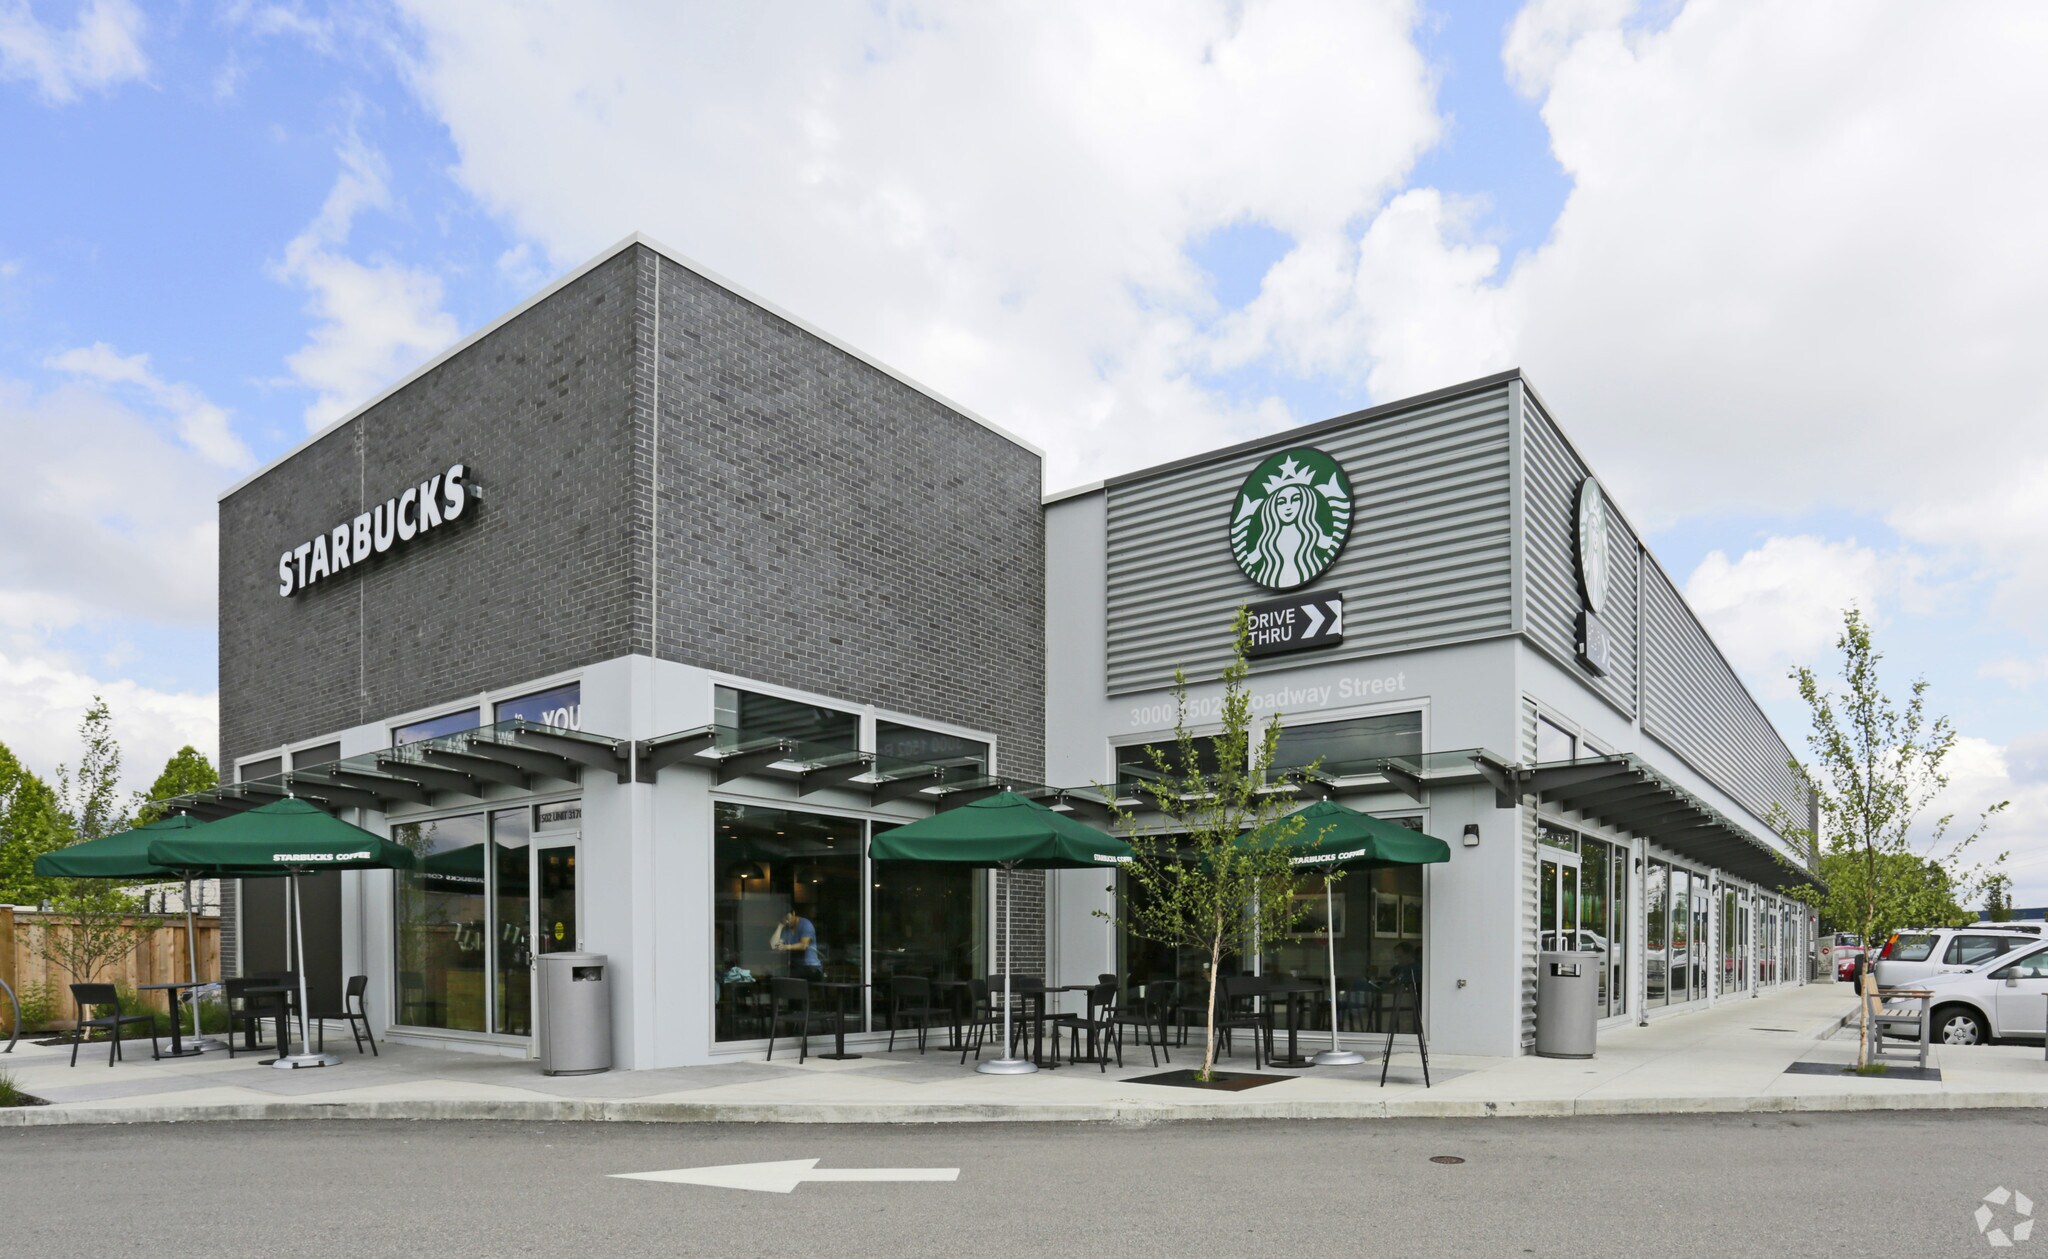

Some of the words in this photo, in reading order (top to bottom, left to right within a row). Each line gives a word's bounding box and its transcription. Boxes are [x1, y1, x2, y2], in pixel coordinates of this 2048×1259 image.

[279, 464, 465, 598] STARBUCKS
[1247, 608, 1295, 631] DRIVE
[1248, 626, 1292, 647] THRU
[1130, 703, 1172, 727] 3000
[1240, 685, 1331, 711] oadway
[1338, 671, 1406, 699] Street
[273, 853, 334, 862] STARBUCKS
[336, 851, 371, 861] COFFEE
[1288, 853, 1337, 866] STARBUCKS
[1338, 848, 1366, 860] COFFEE
